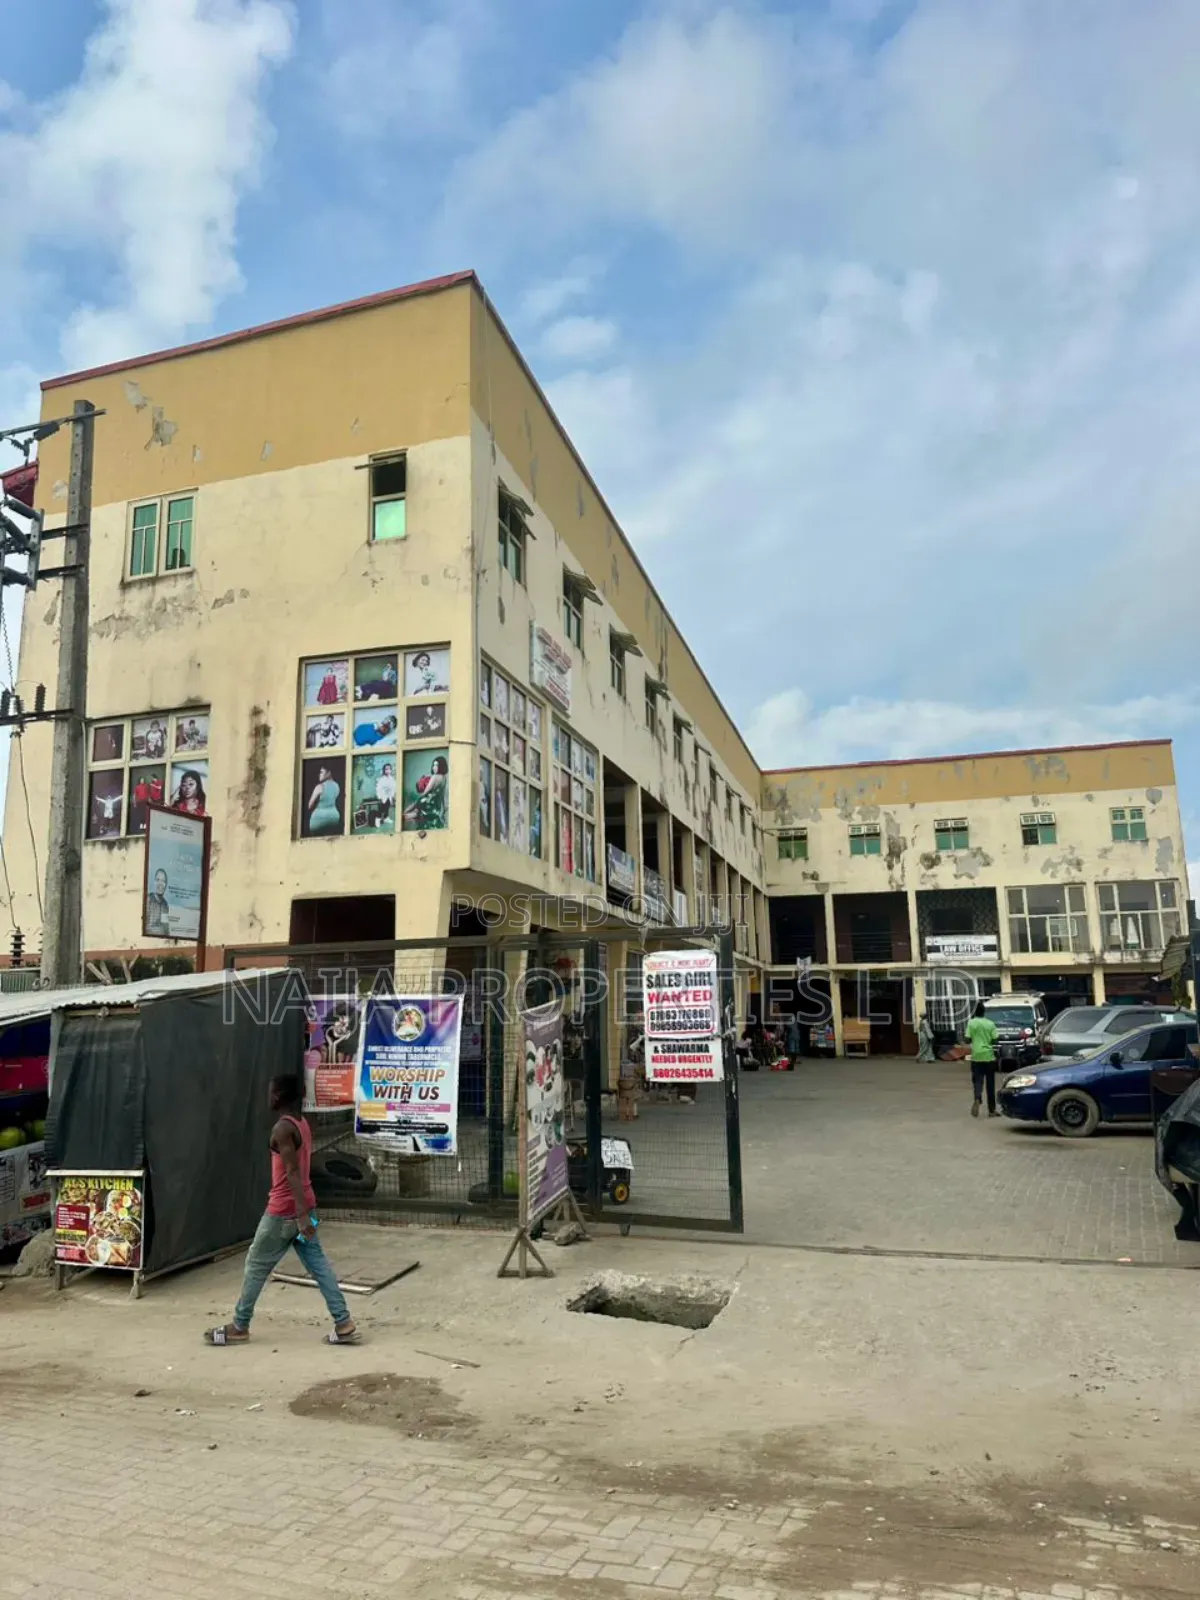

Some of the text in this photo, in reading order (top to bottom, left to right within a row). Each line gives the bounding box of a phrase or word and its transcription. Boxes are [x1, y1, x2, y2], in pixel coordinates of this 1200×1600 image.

[940, 944, 985, 953] LAW OFFICE
[646, 971, 714, 989] SALES GIRL
[647, 990, 712, 1004] WANTED
[660, 1043, 710, 1054] SHAWARMA
[651, 1054, 713, 1064] NEEDED URGENTLY
[371, 1067, 446, 1082] WORSHIP
[373, 1085, 440, 1100] WITH US
[88, 1177, 134, 1191] KITCHEN
